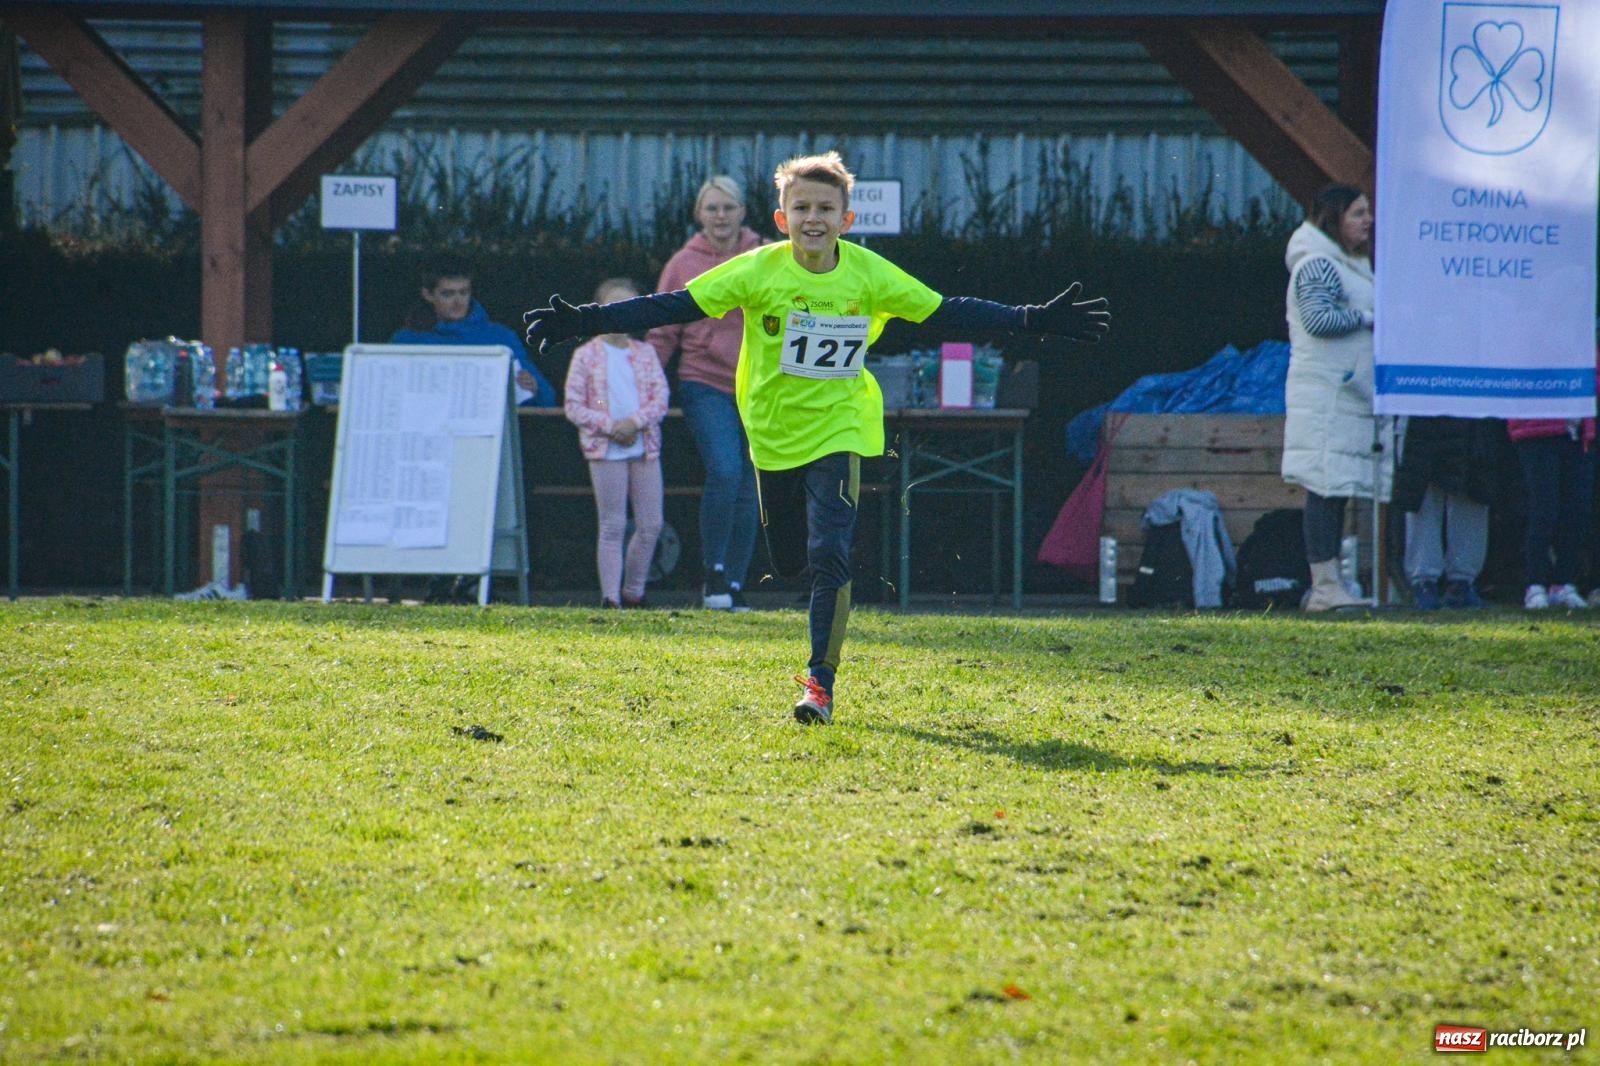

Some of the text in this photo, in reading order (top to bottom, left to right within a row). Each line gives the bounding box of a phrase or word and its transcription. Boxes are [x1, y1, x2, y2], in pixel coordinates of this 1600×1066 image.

[333, 182, 385, 197] ZAPISY
[851, 187, 883, 202] IEGI
[1452, 188, 1528, 209] GMINA
[1418, 220, 1560, 245] PIETROWICE
[1441, 256, 1534, 279] WIELKIE
[789, 335, 863, 368] 127
[1396, 374, 1583, 391] www.pietrowicewielkie.com.pl
